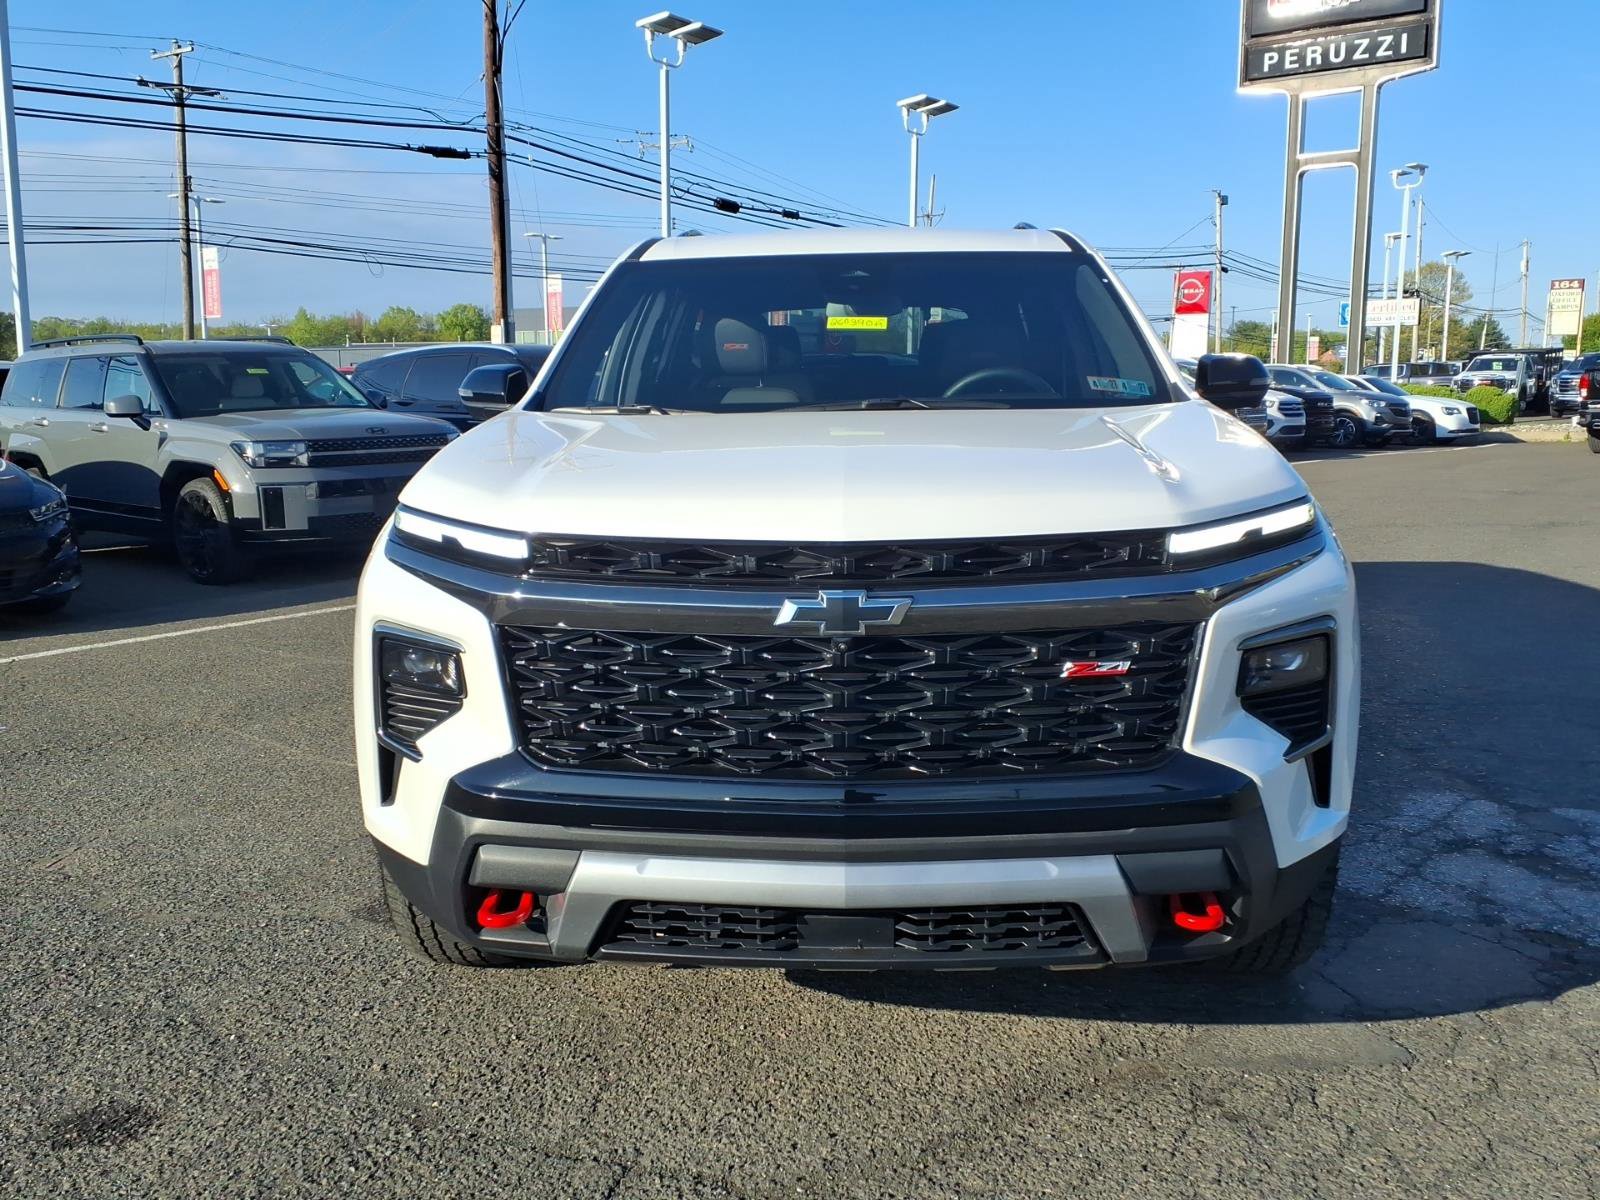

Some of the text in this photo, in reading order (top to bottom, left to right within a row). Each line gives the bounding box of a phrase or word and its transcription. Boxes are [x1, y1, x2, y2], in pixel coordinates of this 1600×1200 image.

[1263, 33, 1408, 73] PERUZZI
[1553, 280, 1580, 289] 164
[1060, 661, 1131, 678] Z71
